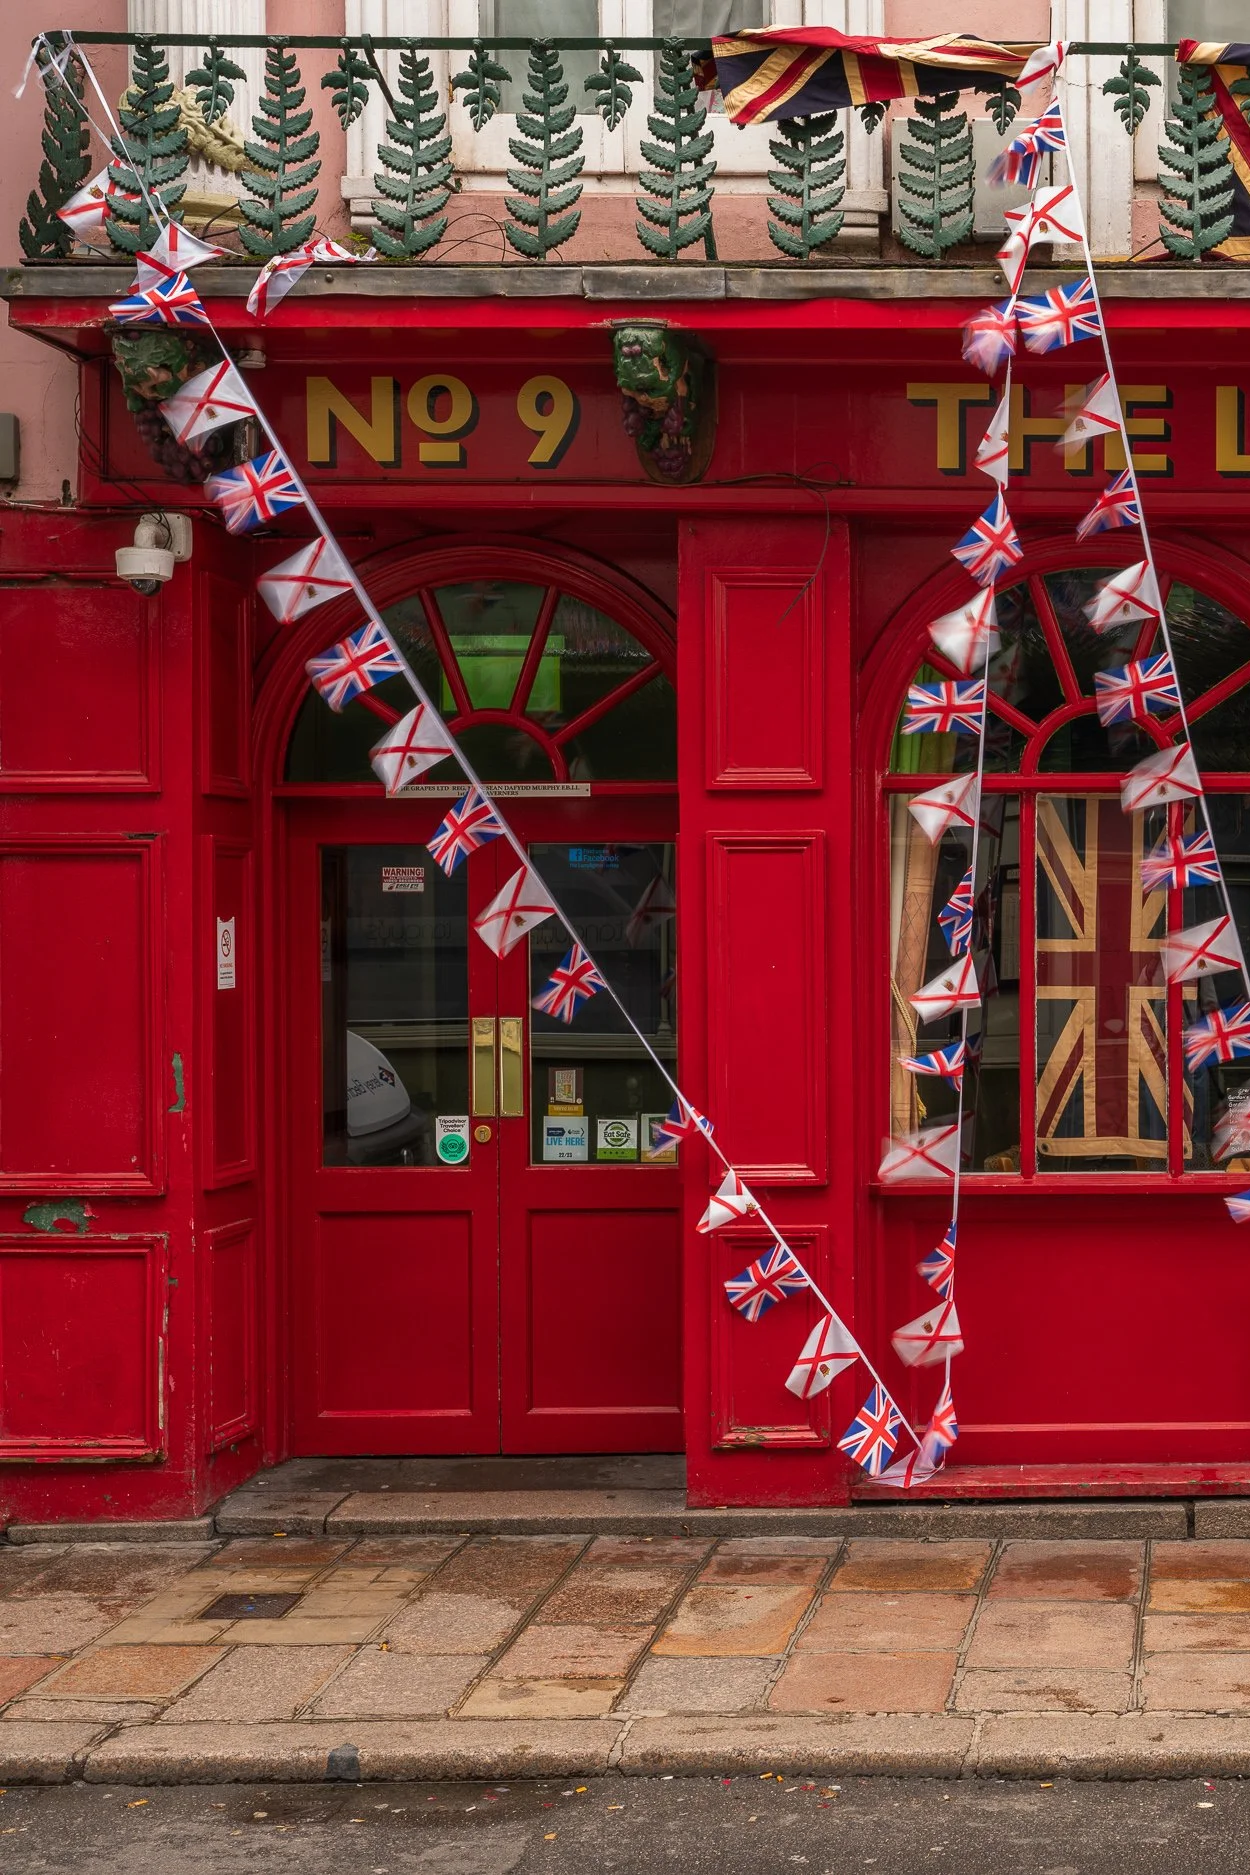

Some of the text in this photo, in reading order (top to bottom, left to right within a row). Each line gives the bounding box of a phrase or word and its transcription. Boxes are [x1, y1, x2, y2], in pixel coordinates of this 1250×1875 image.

[517, 375, 577, 465] 9
[907, 383, 1169, 473] THE
[583, 854, 620, 862] Facebook
[546, 1137, 585, 1146] LIVE HERE
